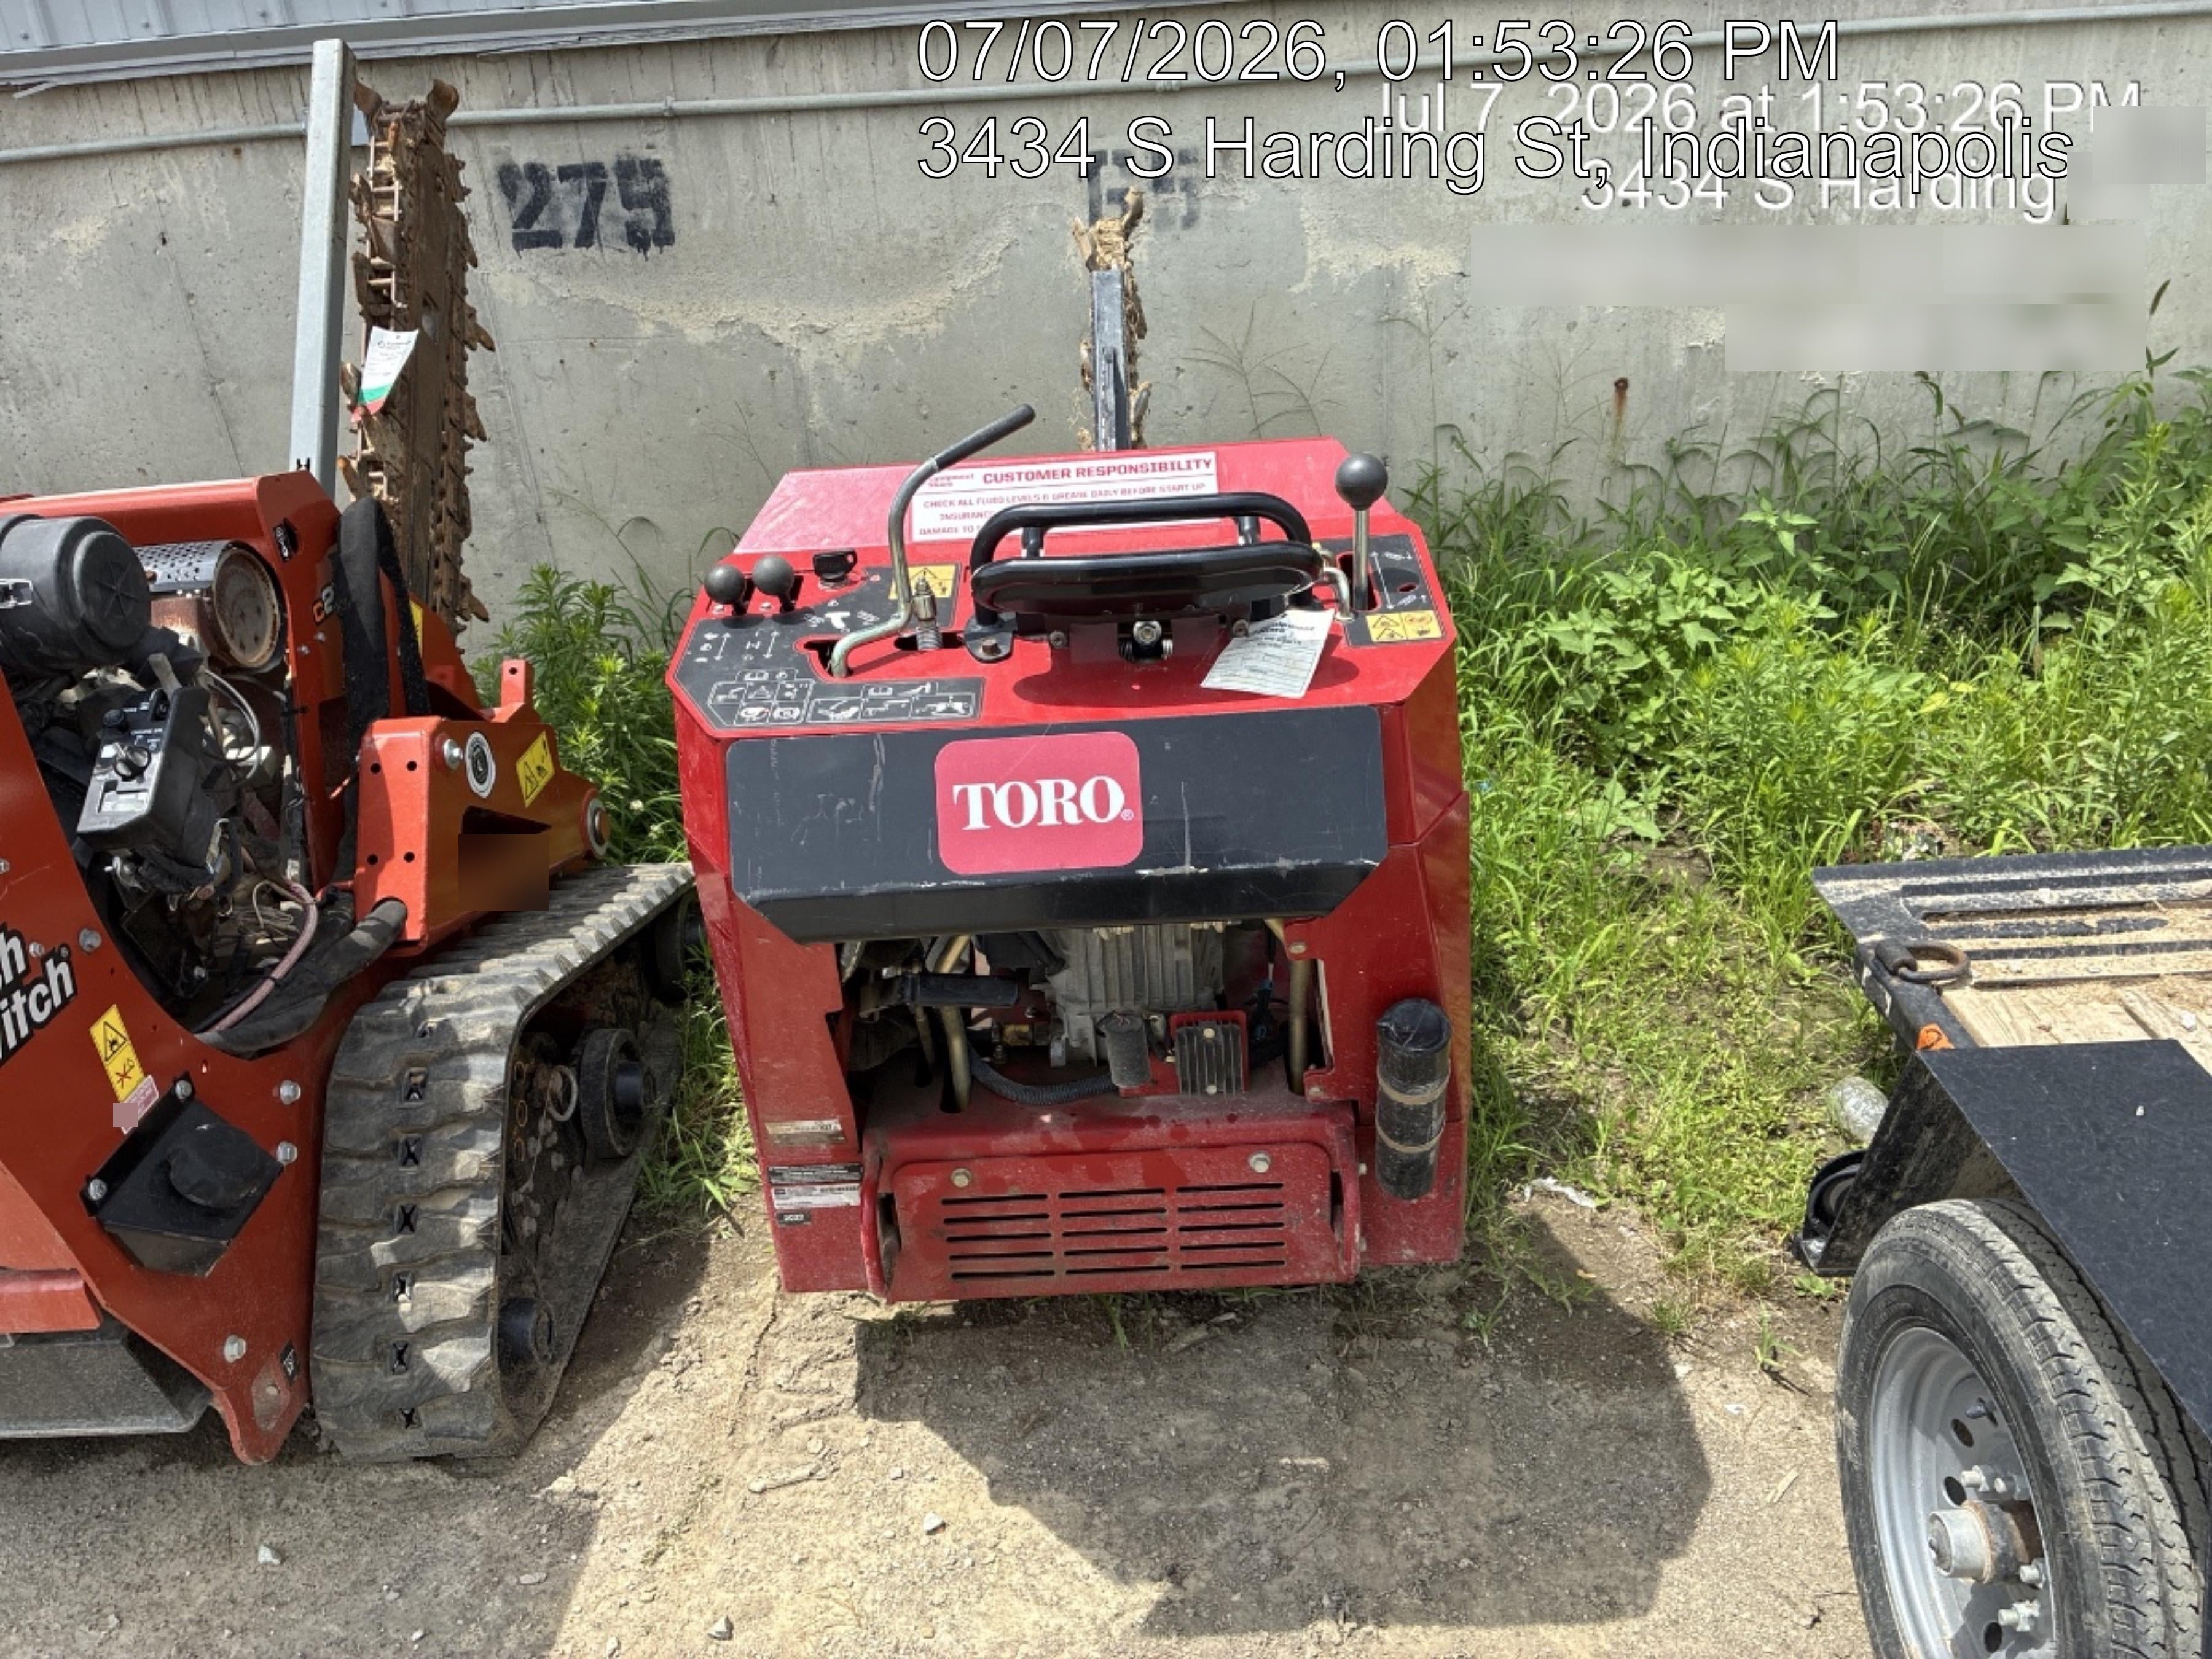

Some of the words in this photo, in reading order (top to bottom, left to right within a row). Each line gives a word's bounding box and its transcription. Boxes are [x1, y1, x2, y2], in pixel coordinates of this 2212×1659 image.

[983, 468, 1071, 484] CUSTOMER
[1076, 458, 1212, 478] RESPONSIBILITY
[924, 500, 955, 508] CHECK
[1006, 493, 1040, 503] LEVELS
[1052, 492, 1088, 500] GREASE
[1091, 489, 1118, 498] DAILY
[1121, 486, 1156, 495] BEFORE
[1159, 484, 1188, 492] START
[919, 527, 958, 535] DAMAGE
[952, 775, 1125, 830] TORO
[0, 957, 74, 1061] itch
